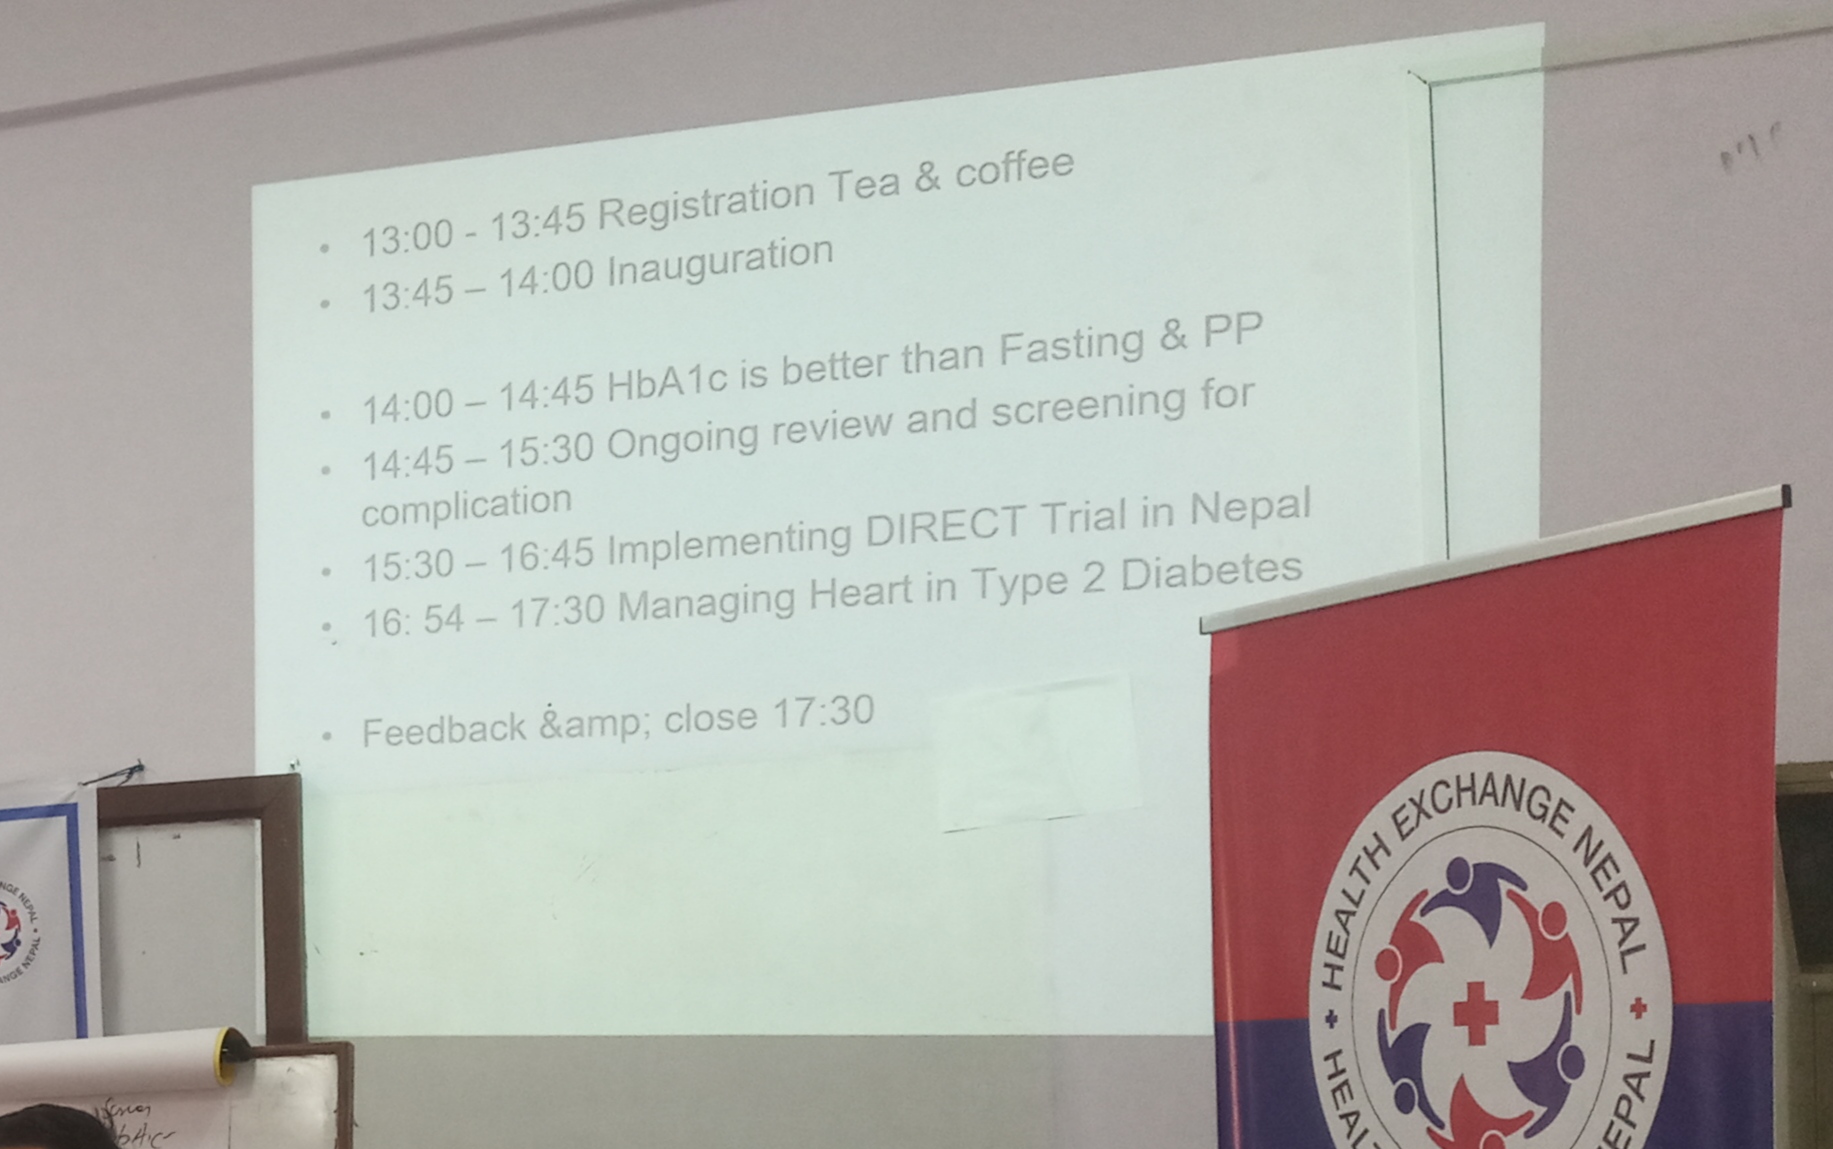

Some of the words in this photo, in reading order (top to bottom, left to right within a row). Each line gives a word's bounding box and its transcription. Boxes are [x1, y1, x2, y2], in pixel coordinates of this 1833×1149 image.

[364, 218, 454, 258] 13:00
[492, 202, 586, 243] 13:45
[598, 178, 814, 231] Registration
[829, 167, 901, 203] Tea
[915, 160, 942, 192] &
[957, 148, 1075, 188] coffee
[364, 274, 454, 314] 13:45
[500, 259, 594, 299] 14:00
[608, 236, 835, 287] Inauguration
[364, 388, 454, 425] 14:00
[500, 373, 594, 411] 14:45
[608, 364, 729, 402] HbA1c
[740, 359, 768, 391] is
[781, 349, 889, 387] better
[902, 340, 984, 377] than
[1001, 325, 1145, 366] Fasting
[1160, 317, 1188, 351] &
[1203, 310, 1263, 348] PP
[364, 443, 454, 481] 14:45
[500, 430, 594, 470] 15:30
[608, 418, 759, 462] Ongoing
[771, 410, 894, 447] review
[907, 398, 978, 435] and
[991, 385, 1187, 428] screening
[1200, 376, 1256, 411] for
[361, 484, 573, 532] complication
[364, 547, 454, 584] 15:30
[500, 536, 594, 573] 16:45
[608, 520, 852, 569] Implementing
[866, 504, 1027, 548] DIRECT
[1041, 498, 1125, 535] Trial
[1141, 494, 1174, 528] in
[1190, 485, 1311, 529] Nepal
[364, 608, 411, 640] 16:
[424, 603, 465, 636] 54
[510, 594, 605, 630] 17:30
[618, 583, 795, 624] Managing
[810, 572, 912, 610] Heart
[926, 570, 957, 603] in
[972, 566, 1068, 606] Type
[1082, 561, 1107, 593] 2
[1121, 551, 1304, 592] Diabetes
[363, 710, 527, 748] Feedback
[539, 708, 652, 744] &amp;
[664, 703, 758, 734] close
[774, 693, 875, 730] 17:30
[18, 892, 38, 924] NEPAL
[1322, 832, 1392, 991] HEALTH
[1391, 771, 1575, 842] EXCHANGE
[1572, 825, 1647, 974] NEPAL
[22, 936, 41, 970] NEPAL
